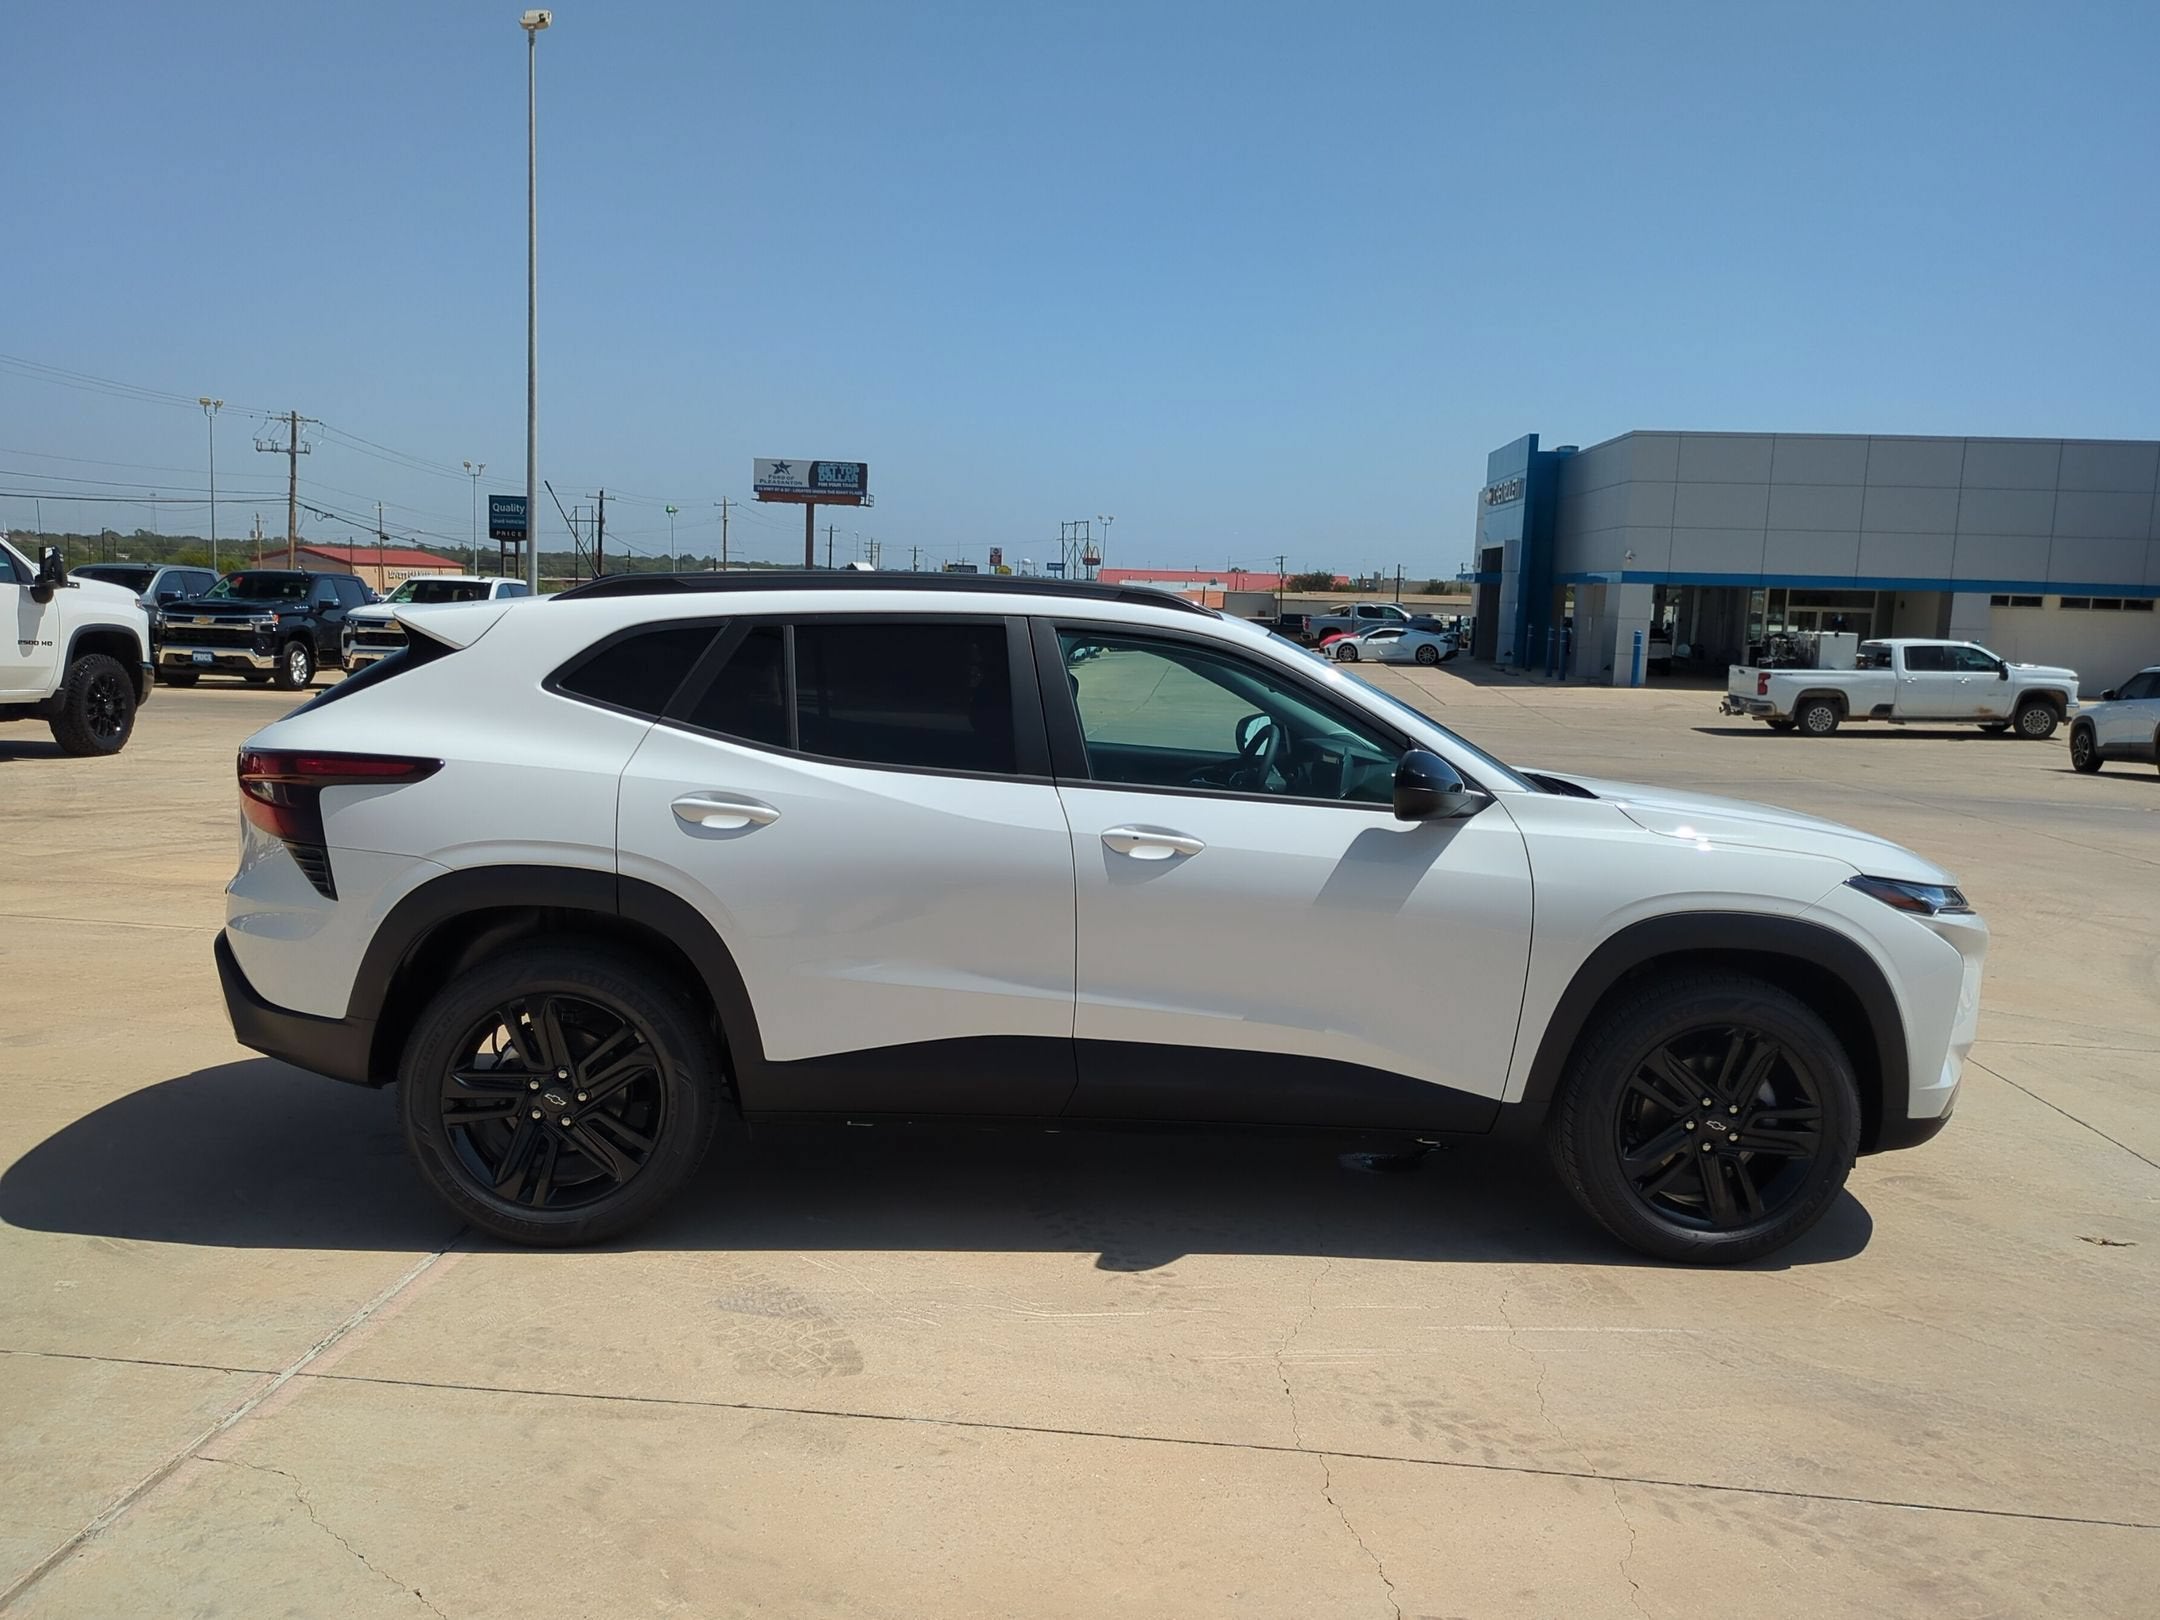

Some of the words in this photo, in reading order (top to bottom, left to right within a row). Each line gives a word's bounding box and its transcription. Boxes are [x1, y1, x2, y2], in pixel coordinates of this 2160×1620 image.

[818, 474, 858, 482] DOLLAR
[492, 502, 526, 515] Quality
[17, 639, 40, 647] 2500
